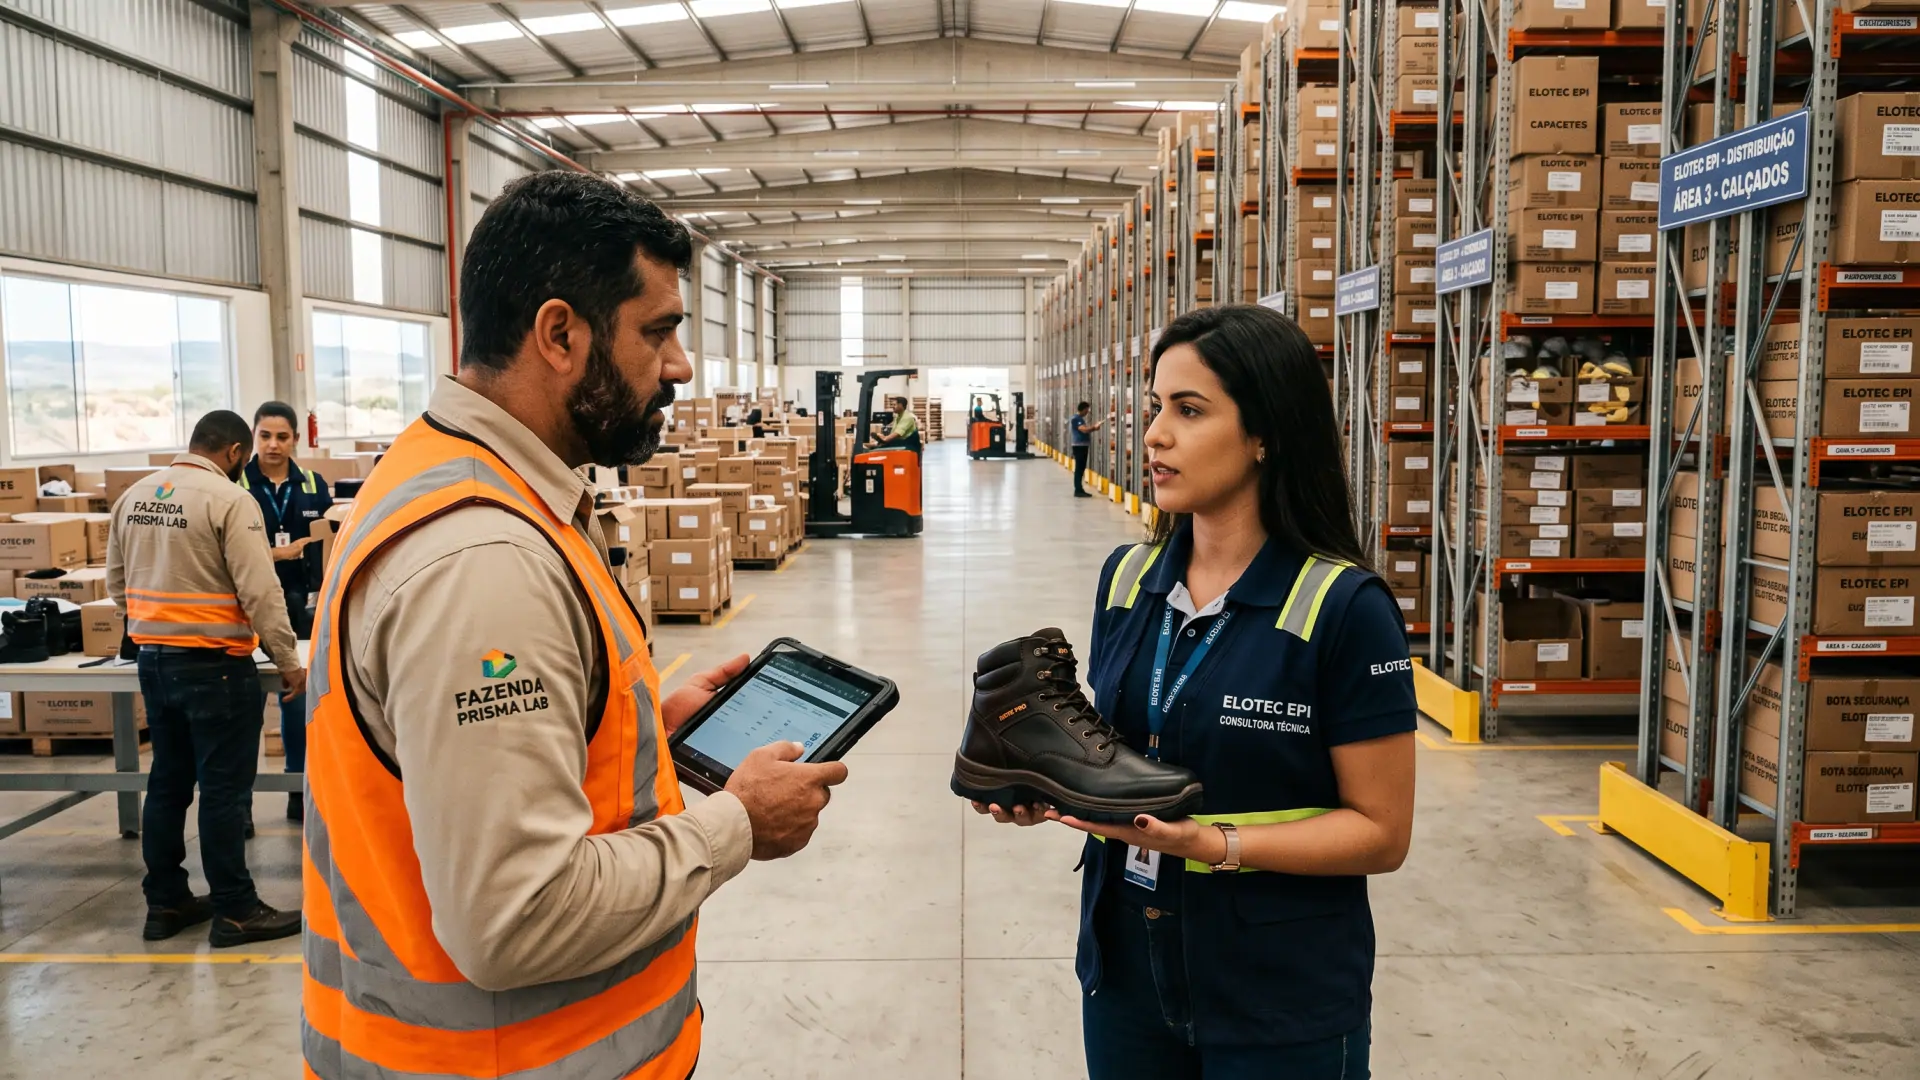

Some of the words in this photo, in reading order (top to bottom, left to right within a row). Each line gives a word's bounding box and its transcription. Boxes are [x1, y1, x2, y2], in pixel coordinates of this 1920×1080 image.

[1529, 88, 1570, 96] ELOTEC
[1572, 88, 1590, 96] EPI
[1530, 120, 1588, 129] CAPACETES
[1674, 158, 1704, 182] ELOTEC
[1706, 152, 1720, 172] EPI
[1727, 127, 1795, 166] DISTRIBUIÇÃO
[1673, 186, 1702, 213] ÁREA
[1704, 183, 1712, 204] 3
[1721, 161, 1790, 200] CALÇADOS
[1876, 192, 1920, 202] ELOTEC
[1776, 222, 1799, 236] ELOT
[1842, 328, 1890, 338] ELOTEC
[1894, 328, 1912, 338] EPI
[1767, 341, 1792, 351] ELOTEC
[1843, 388, 1890, 398] ELOTEC
[1894, 388, 1912, 398] EPI
[1766, 398, 1792, 408] ELOTEC
[134, 502, 183, 515] FAZENDA
[1675, 496, 1697, 510] ELOTE
[1843, 507, 1890, 516] ELOTEC
[1894, 506, 1913, 516] EPI
[127, 514, 164, 526] PRISMA
[166, 517, 188, 529] LAB
[1840, 578, 1887, 588] ELOTEC
[1890, 578, 1908, 588] EPI
[1370, 658, 1410, 676] ELOTEC
[455, 677, 544, 709] FAZENDA
[1222, 694, 1284, 714] ELOTEC
[1287, 702, 1312, 718] EPI
[1826, 696, 1852, 706] BOTA
[1853, 696, 1910, 708] SEGURANÇA
[457, 700, 520, 726] PRISMA
[523, 696, 548, 712] LAB
[1841, 712, 1868, 722] ELOT
[1220, 715, 1274, 731] CONSULTORA
[1276, 720, 1310, 734] TÉCNICA
[1666, 719, 1688, 738] ELOTE
[1820, 767, 1844, 776] BOTA
[1847, 766, 1904, 778] SEGURANÇA
